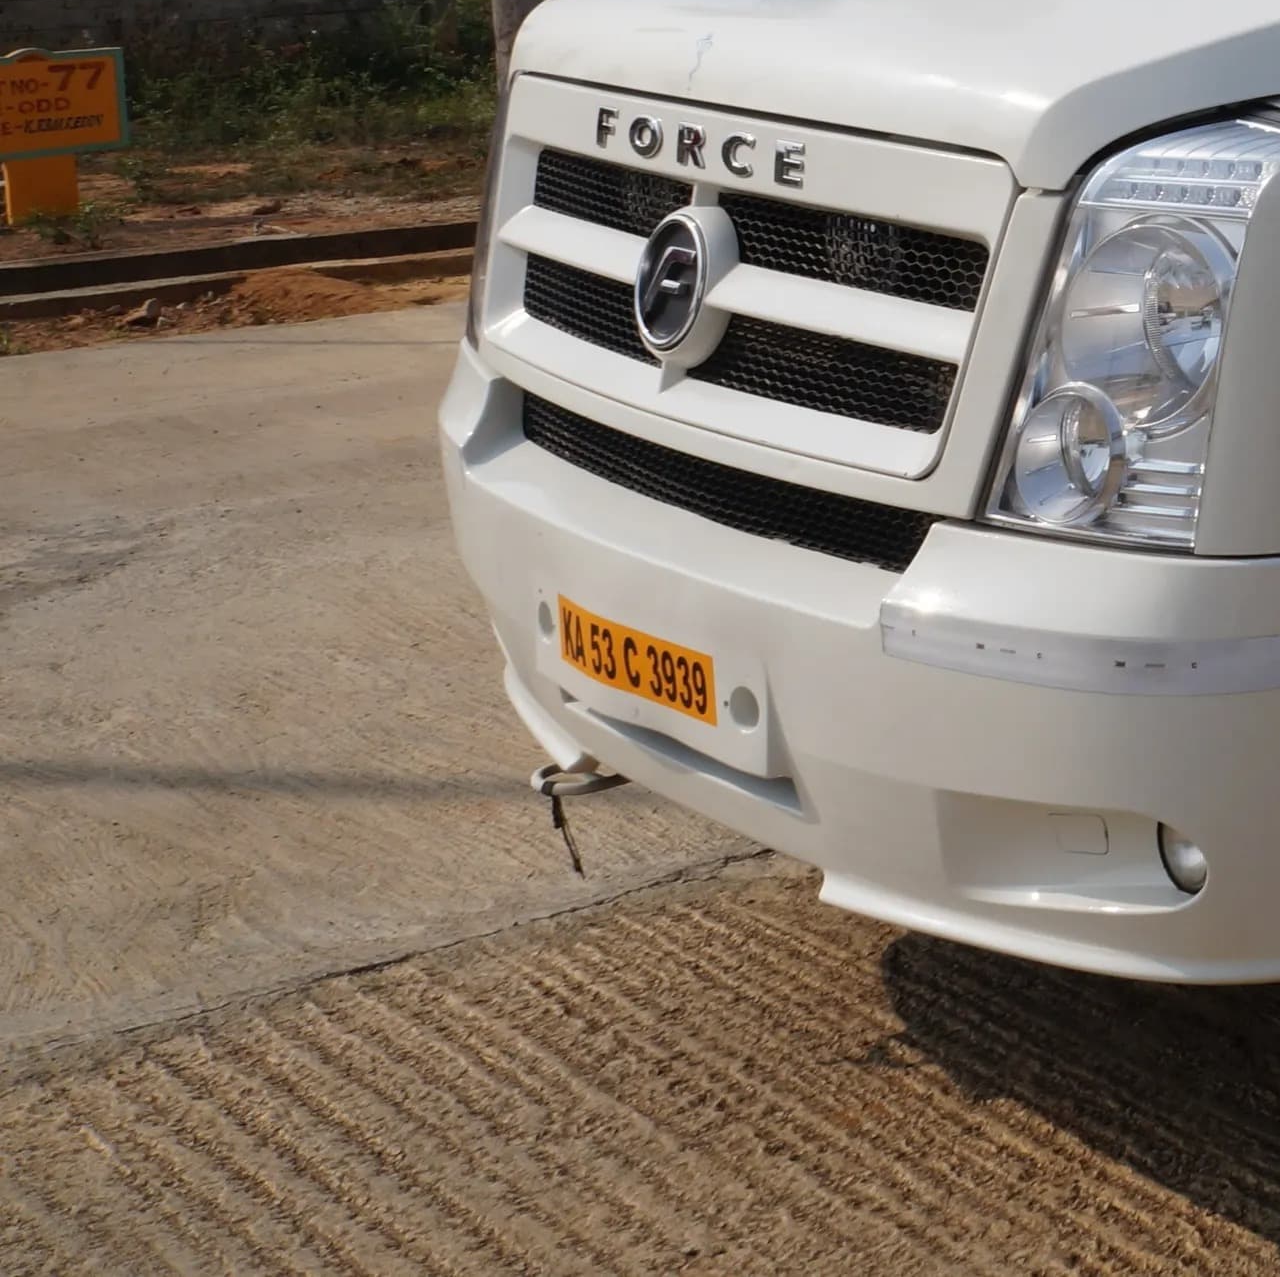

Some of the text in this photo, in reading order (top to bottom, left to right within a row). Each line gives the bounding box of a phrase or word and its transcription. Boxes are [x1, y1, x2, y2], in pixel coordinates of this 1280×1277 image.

[596, 107, 806, 189] FORCE
[562, 606, 708, 715] KA 53 C 3939
